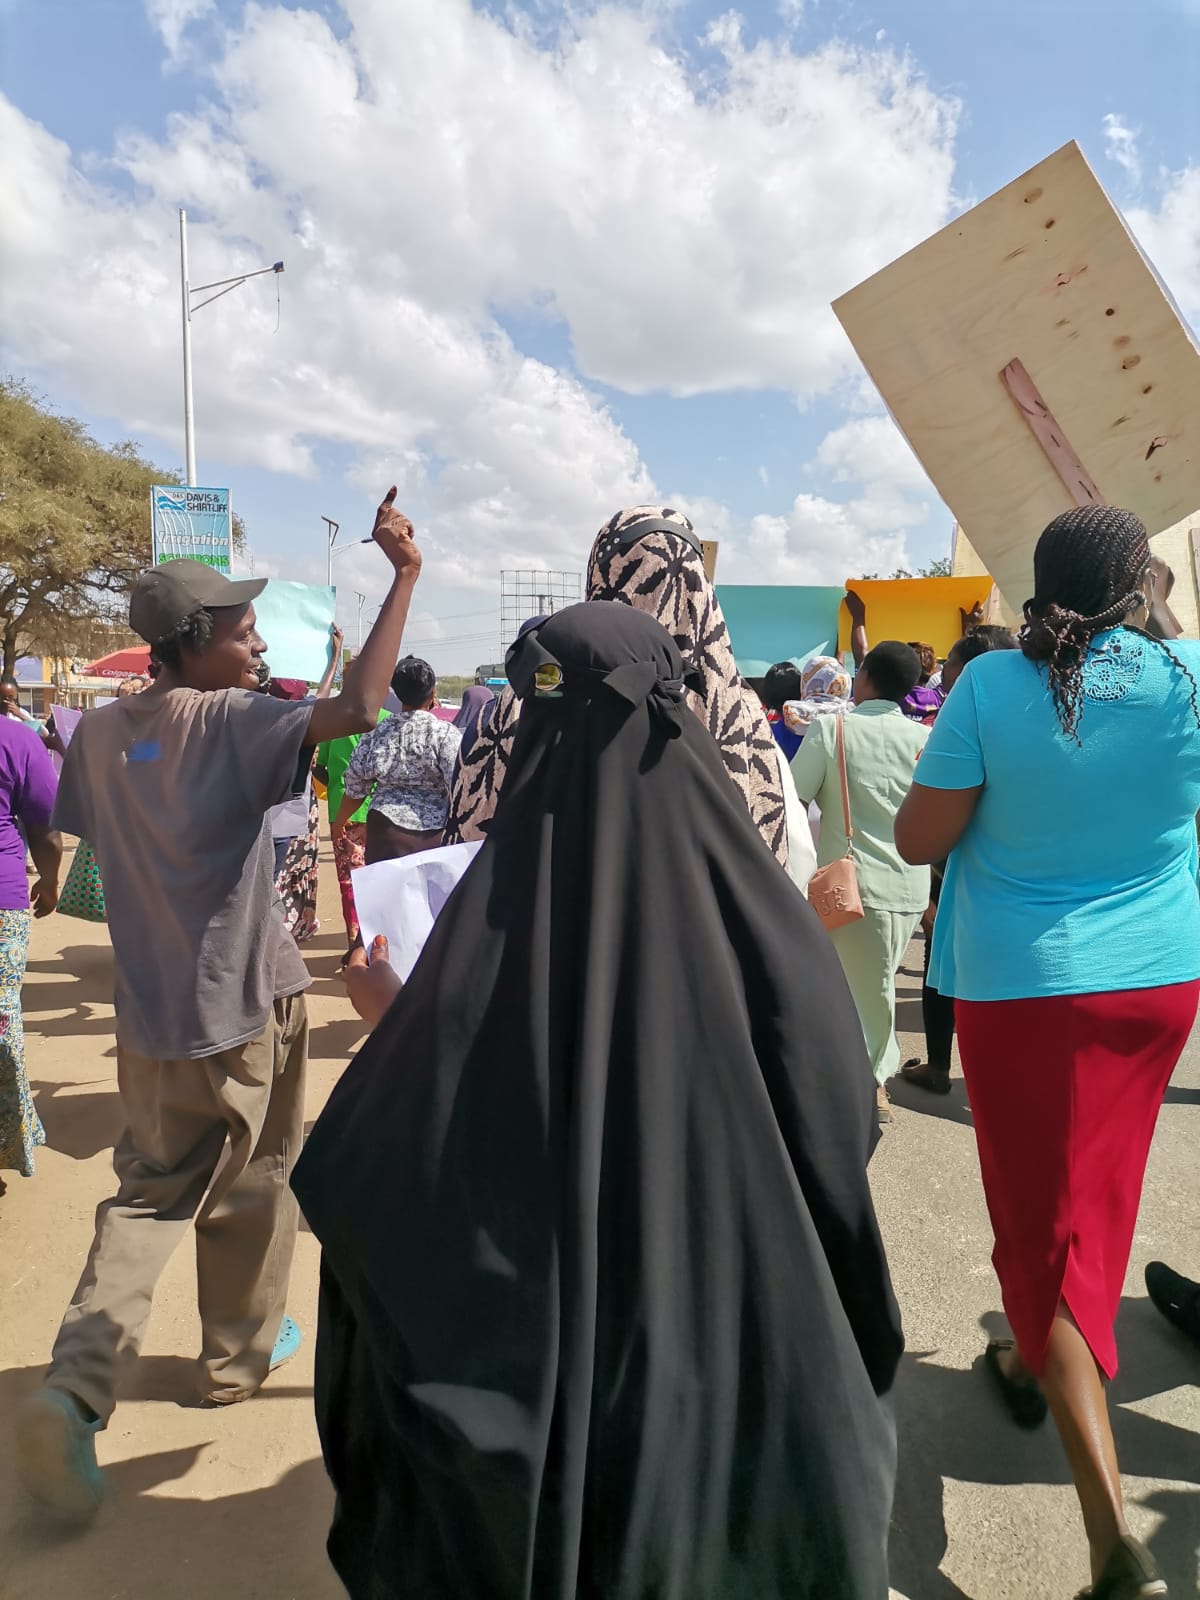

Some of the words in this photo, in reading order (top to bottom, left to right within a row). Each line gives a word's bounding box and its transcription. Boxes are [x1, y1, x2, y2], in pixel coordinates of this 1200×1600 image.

[187, 493, 212, 502] DAVIS
[213, 494, 220, 503] &
[187, 502, 228, 512] SHIRTLIFF
[159, 531, 229, 546] Irrigation
